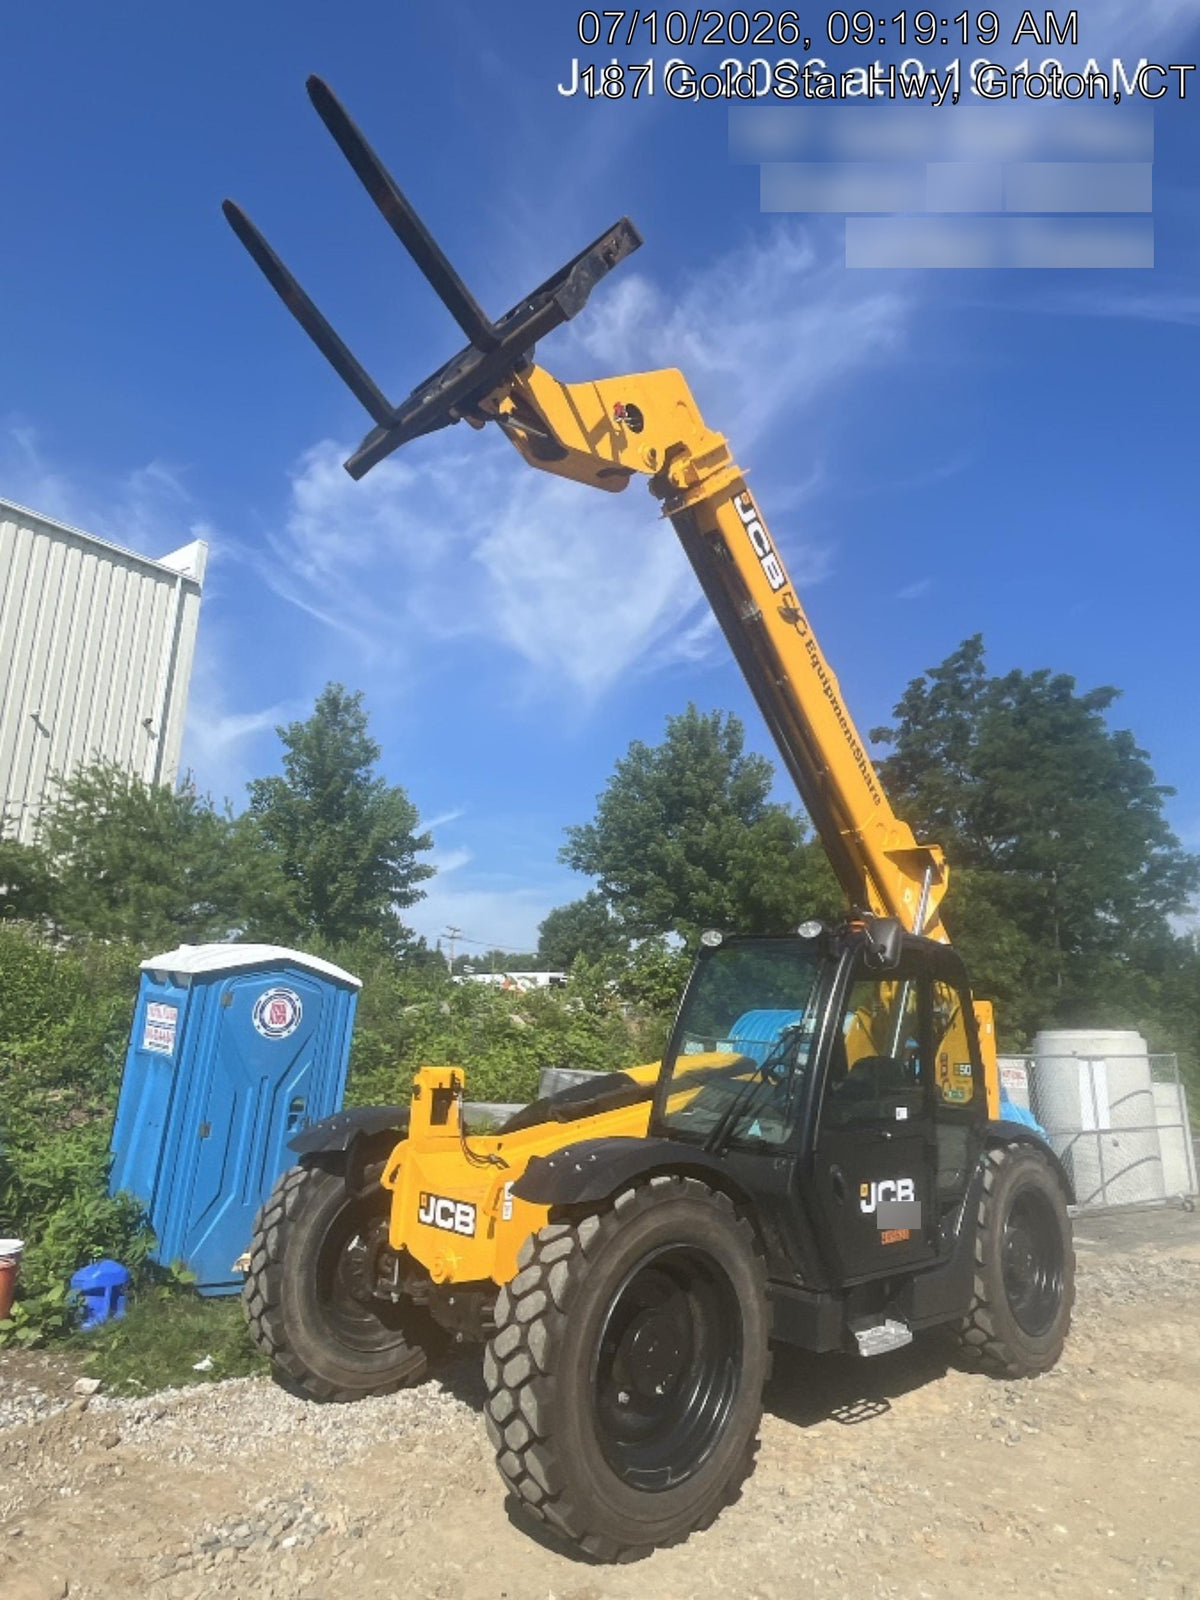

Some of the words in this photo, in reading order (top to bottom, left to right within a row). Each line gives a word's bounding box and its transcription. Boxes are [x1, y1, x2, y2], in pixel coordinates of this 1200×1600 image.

[733, 488, 786, 593] JCB
[805, 639, 882, 807] EquipmentShare
[418, 1193, 476, 1236] JCB
[860, 1178, 915, 1213] JCB
